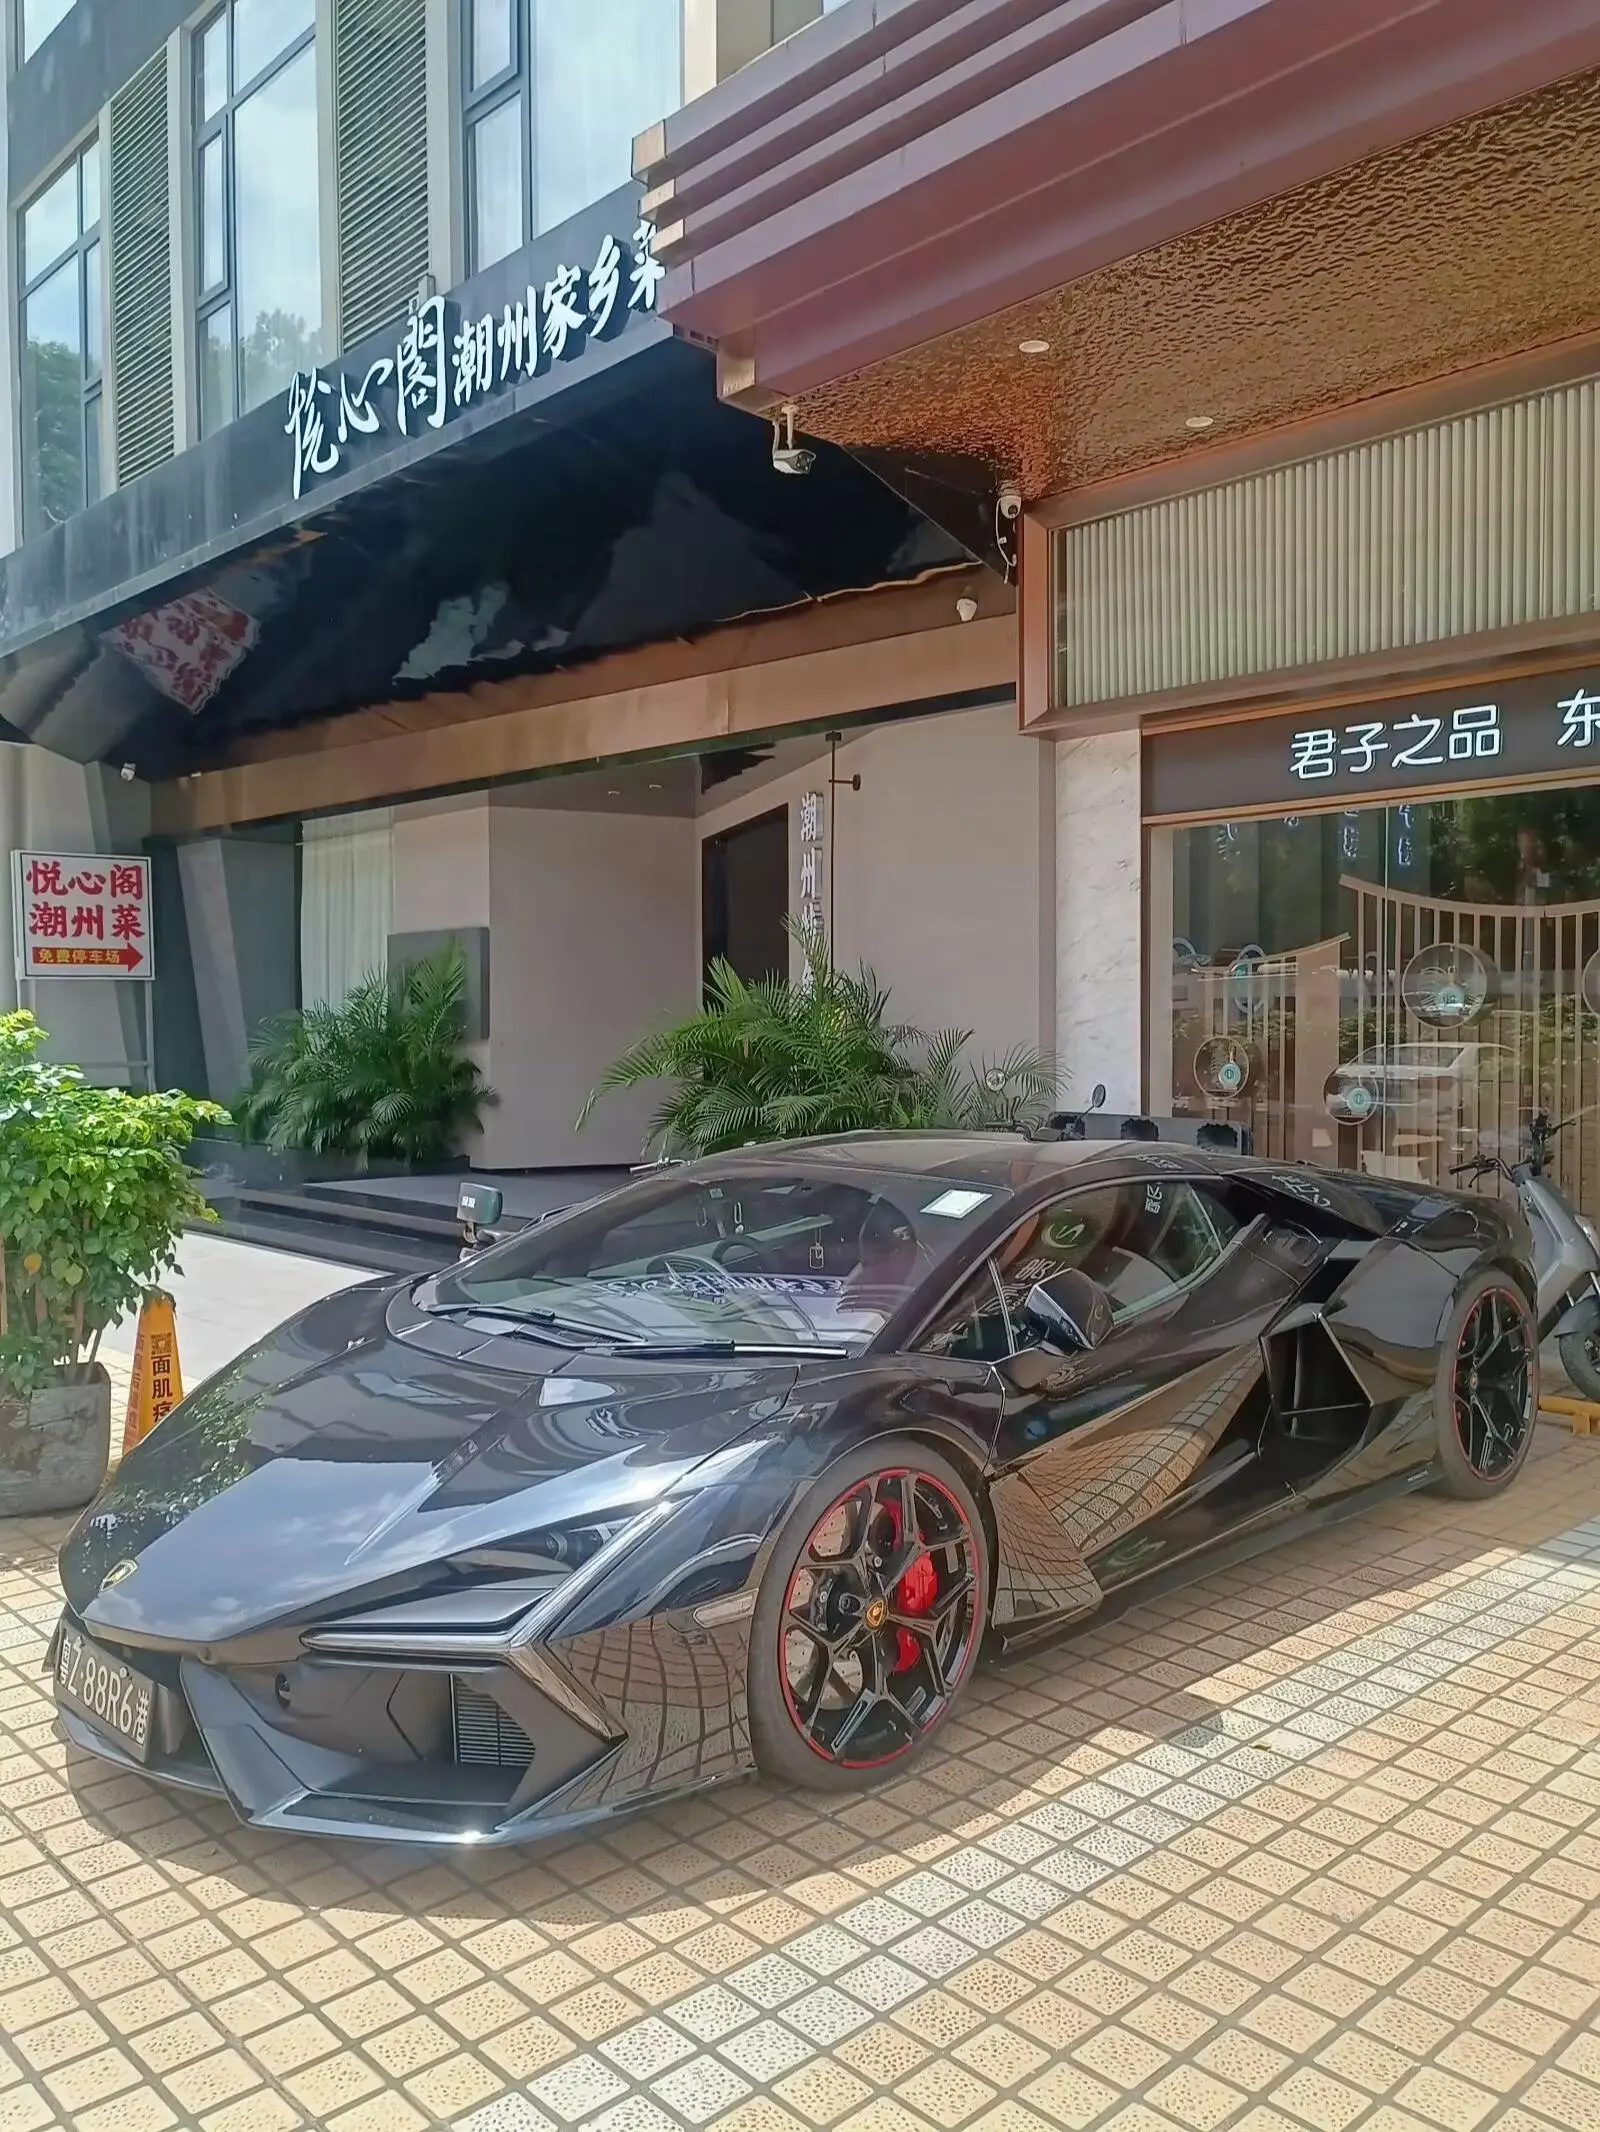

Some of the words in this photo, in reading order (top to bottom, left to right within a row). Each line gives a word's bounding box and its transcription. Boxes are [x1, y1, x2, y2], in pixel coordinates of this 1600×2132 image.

[1289, 704, 1500, 780] 君子之品
[1556, 687, 1600, 748] 东
[26, 860, 144, 901] 悦心阁
[28, 901, 145, 941] 潮州菜
[38, 948, 121, 965] 免费停车场
